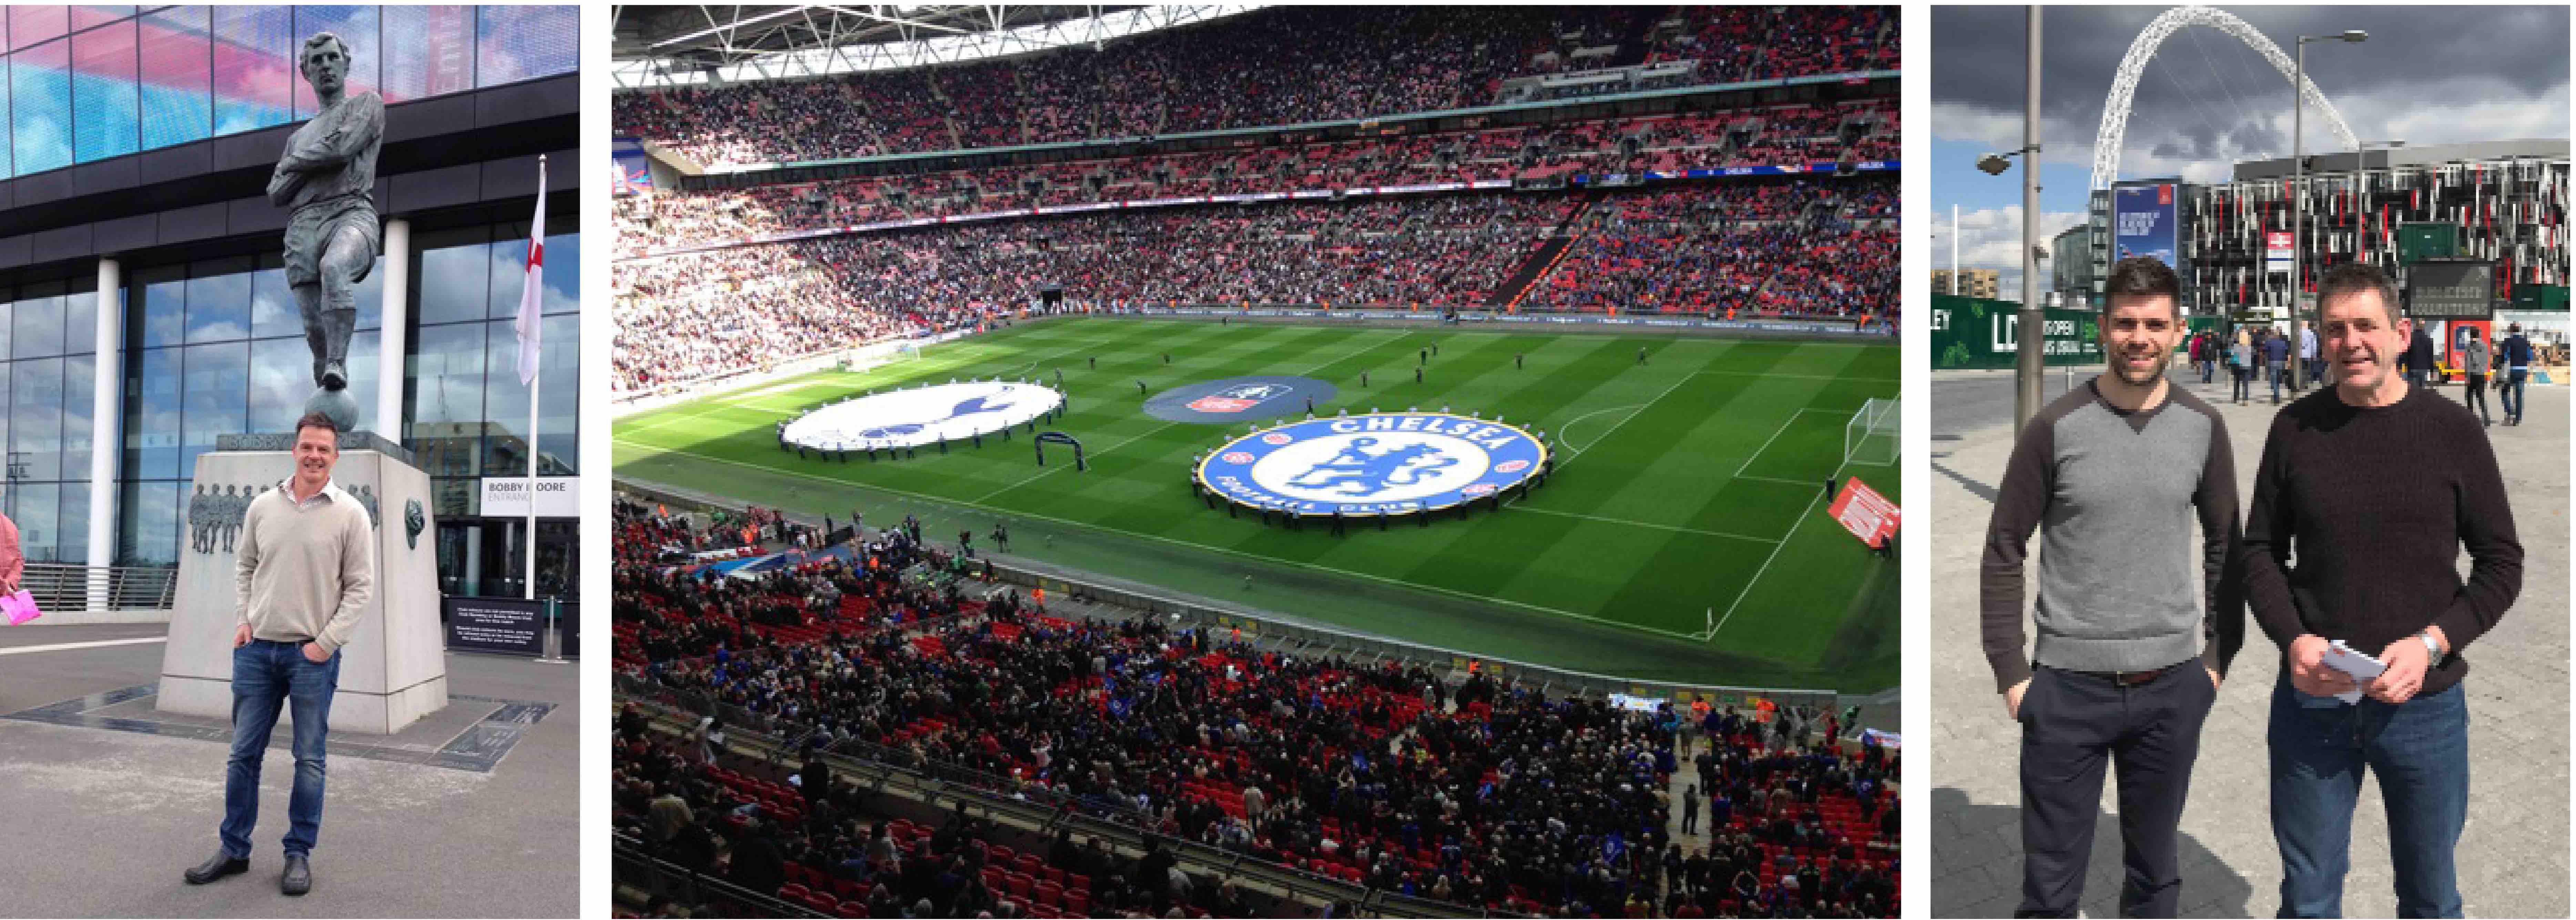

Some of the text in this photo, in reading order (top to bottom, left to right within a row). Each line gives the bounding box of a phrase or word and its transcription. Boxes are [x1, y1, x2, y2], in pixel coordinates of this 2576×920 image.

[1331, 417, 1519, 450] CHELSEA
[489, 482, 566, 491] BOBBY OORE
[489, 492, 530, 502] ENTRANC
